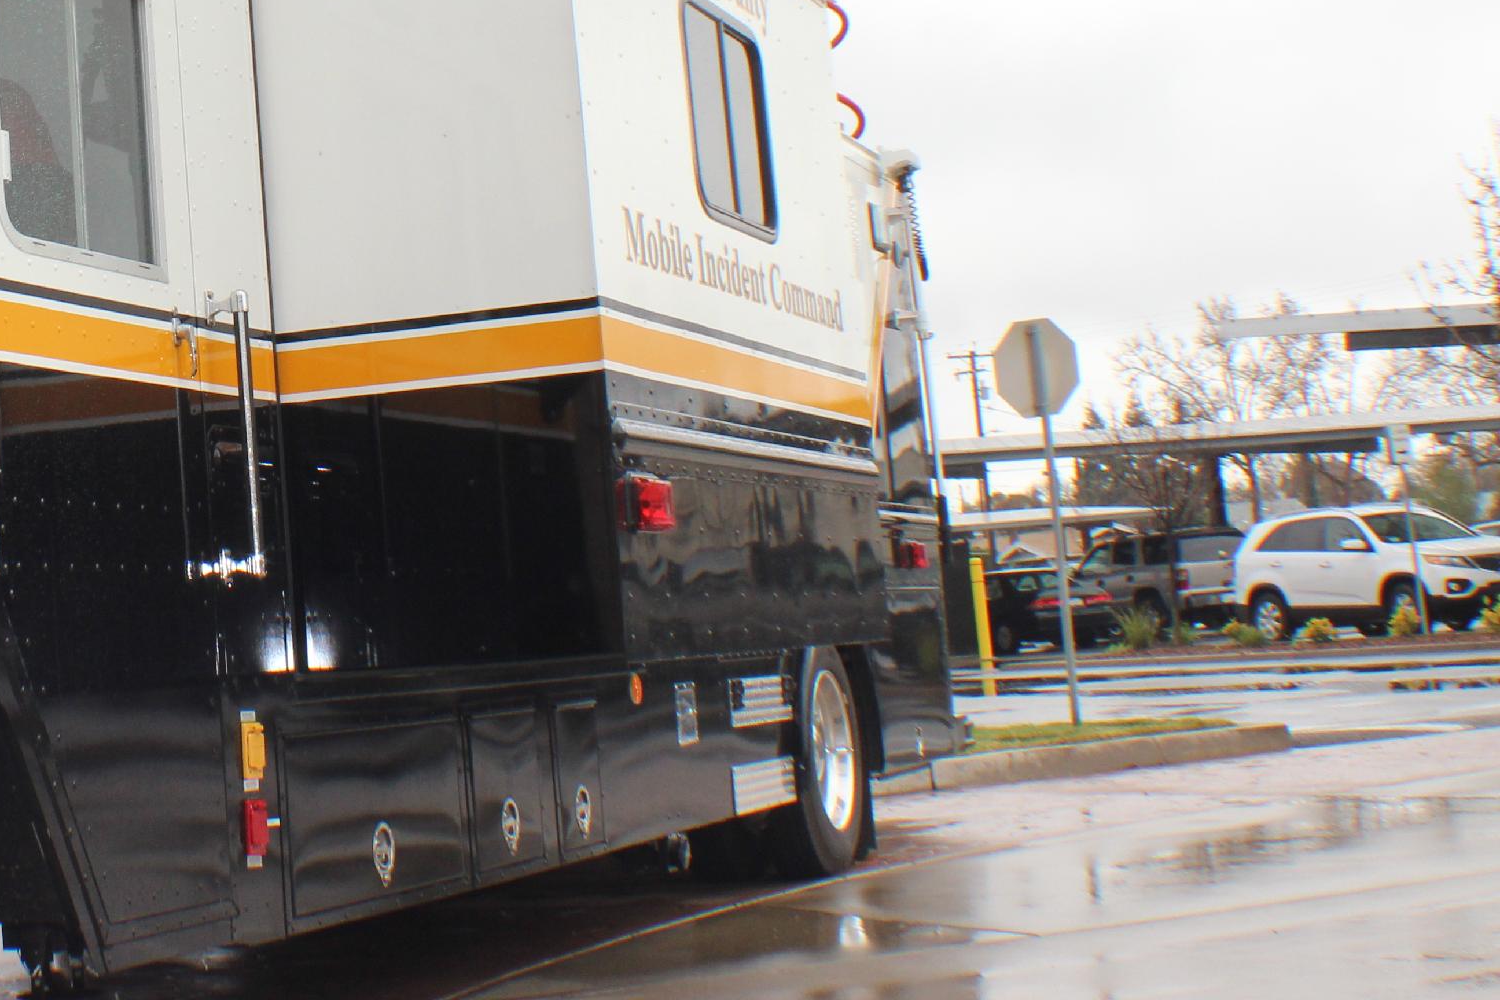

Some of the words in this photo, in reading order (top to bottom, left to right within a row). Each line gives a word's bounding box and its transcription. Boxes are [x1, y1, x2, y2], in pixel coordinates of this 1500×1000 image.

[621, 205, 694, 282] Mobile
[694, 232, 768, 306] Incident
[769, 262, 845, 332] Command
